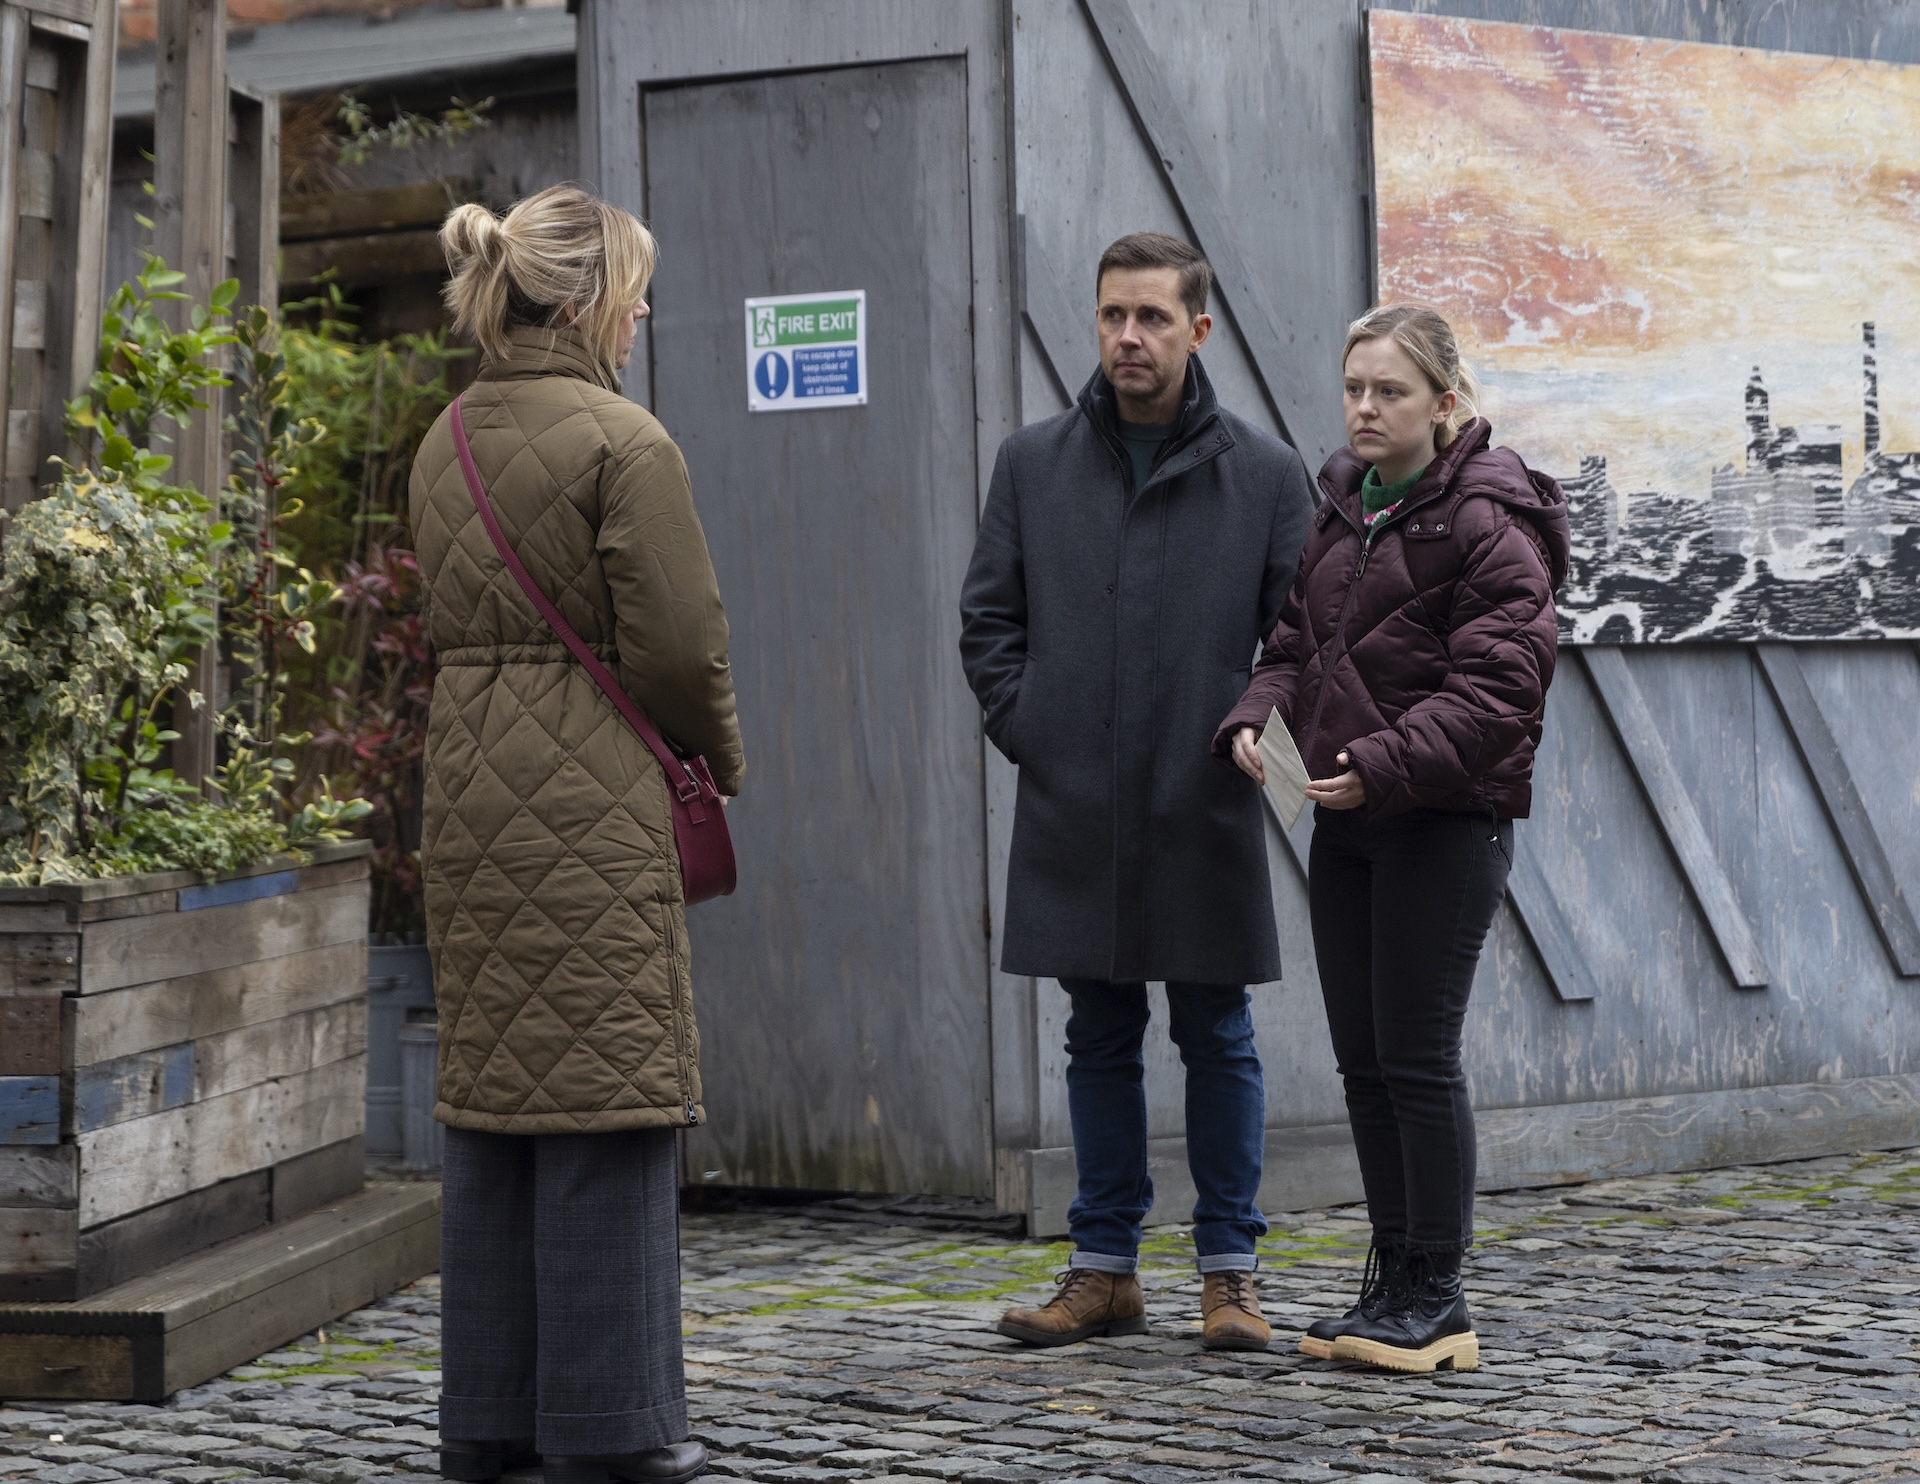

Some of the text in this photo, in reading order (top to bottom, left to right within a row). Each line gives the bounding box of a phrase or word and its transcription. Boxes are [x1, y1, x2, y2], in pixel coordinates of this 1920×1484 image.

[778, 311, 855, 334] FIRE EXIT
[795, 349, 854, 360] Fire escape door
[802, 360, 848, 372] keep clear of
[802, 374, 848, 384] obstructions
[806, 385, 845, 395] at all times
